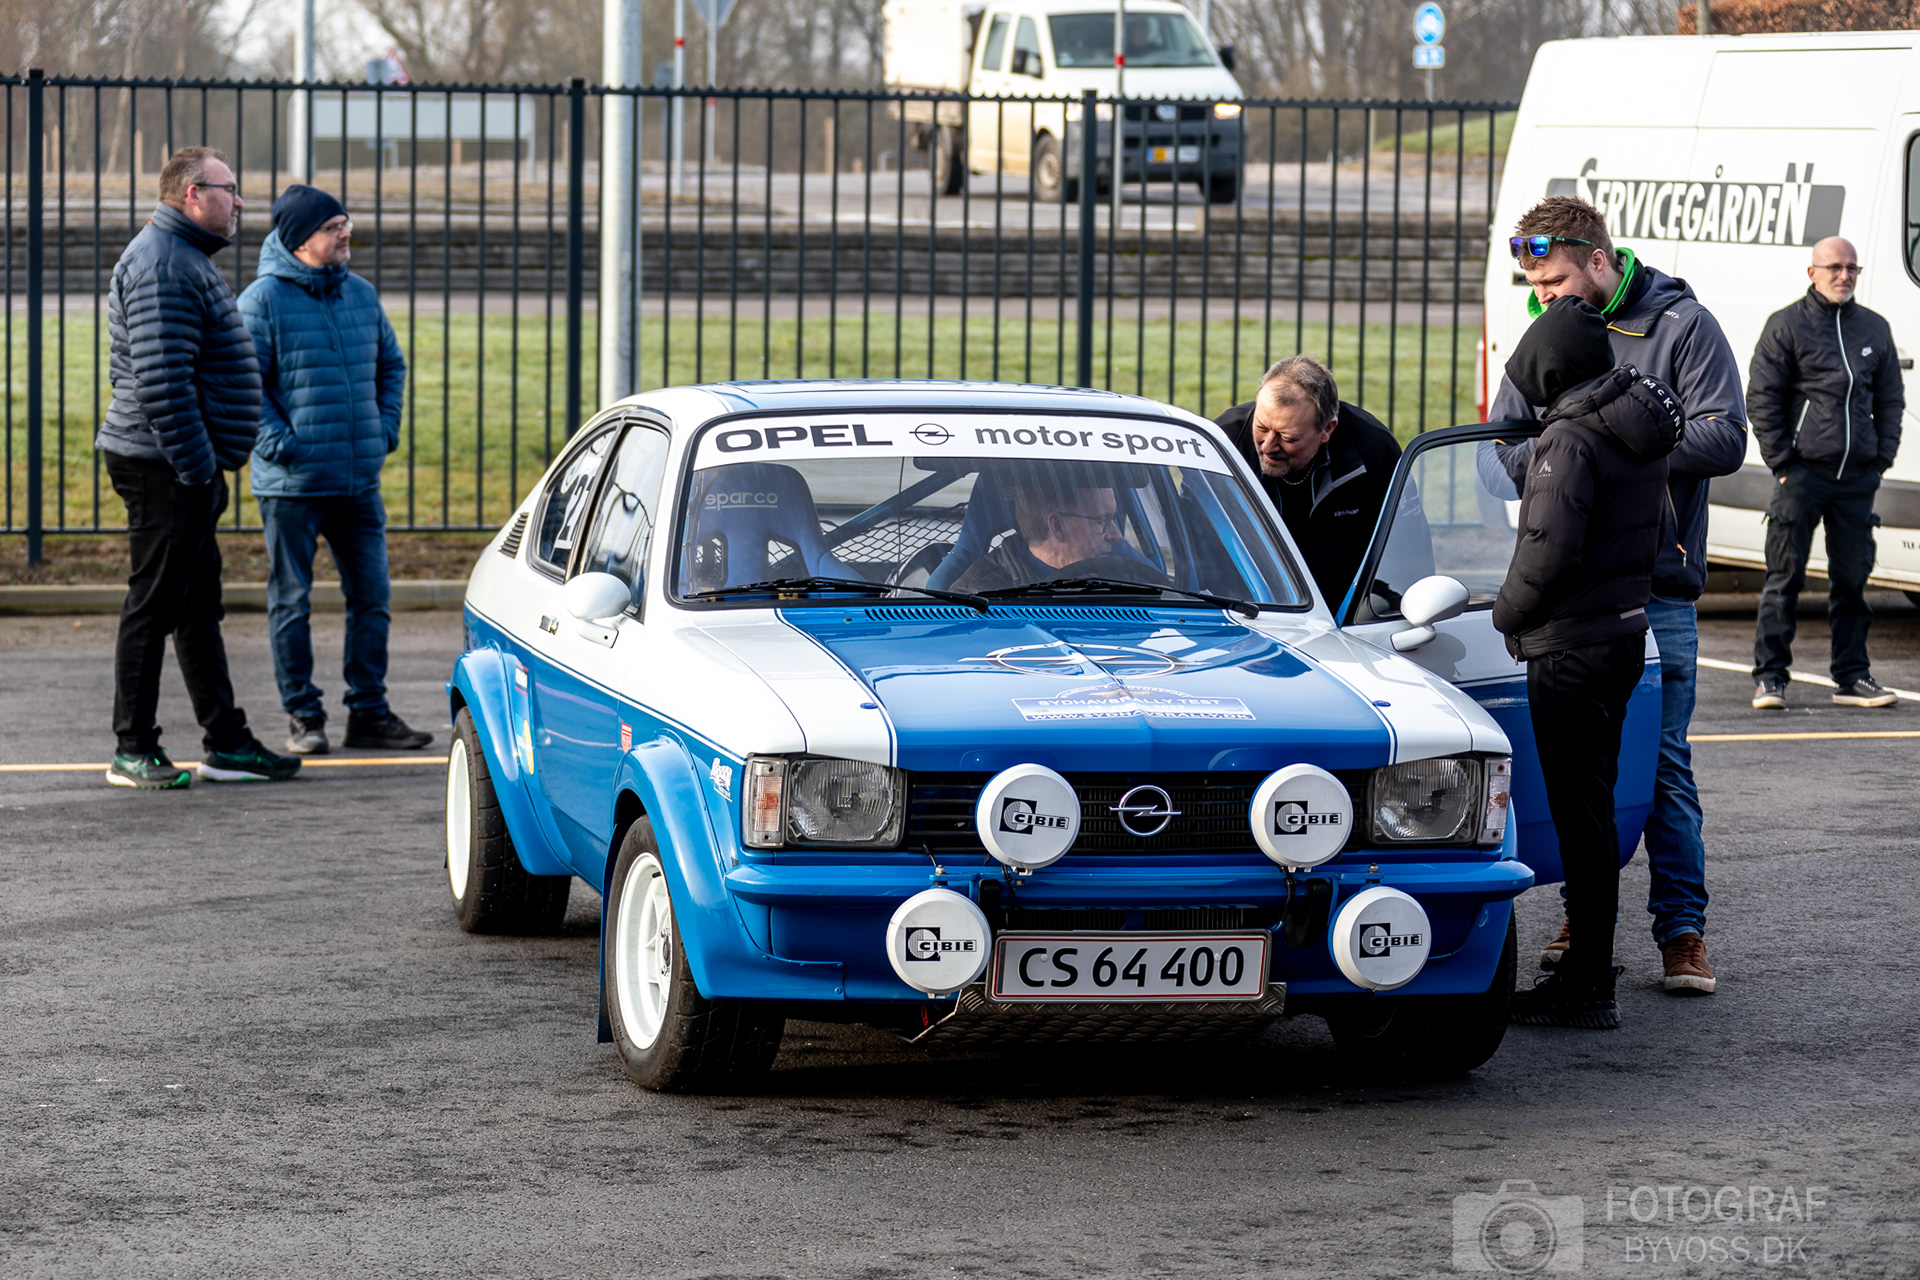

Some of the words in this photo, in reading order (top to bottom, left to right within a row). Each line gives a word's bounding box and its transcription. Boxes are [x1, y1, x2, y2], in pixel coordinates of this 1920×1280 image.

[715, 424, 893, 452] OPEL
[975, 425, 1093, 447] motor
[1101, 431, 1205, 458] sport
[704, 491, 778, 511] sparco
[1018, 947, 1078, 988] CS
[1092, 946, 1148, 988] 64
[1160, 946, 1244, 987] 400
